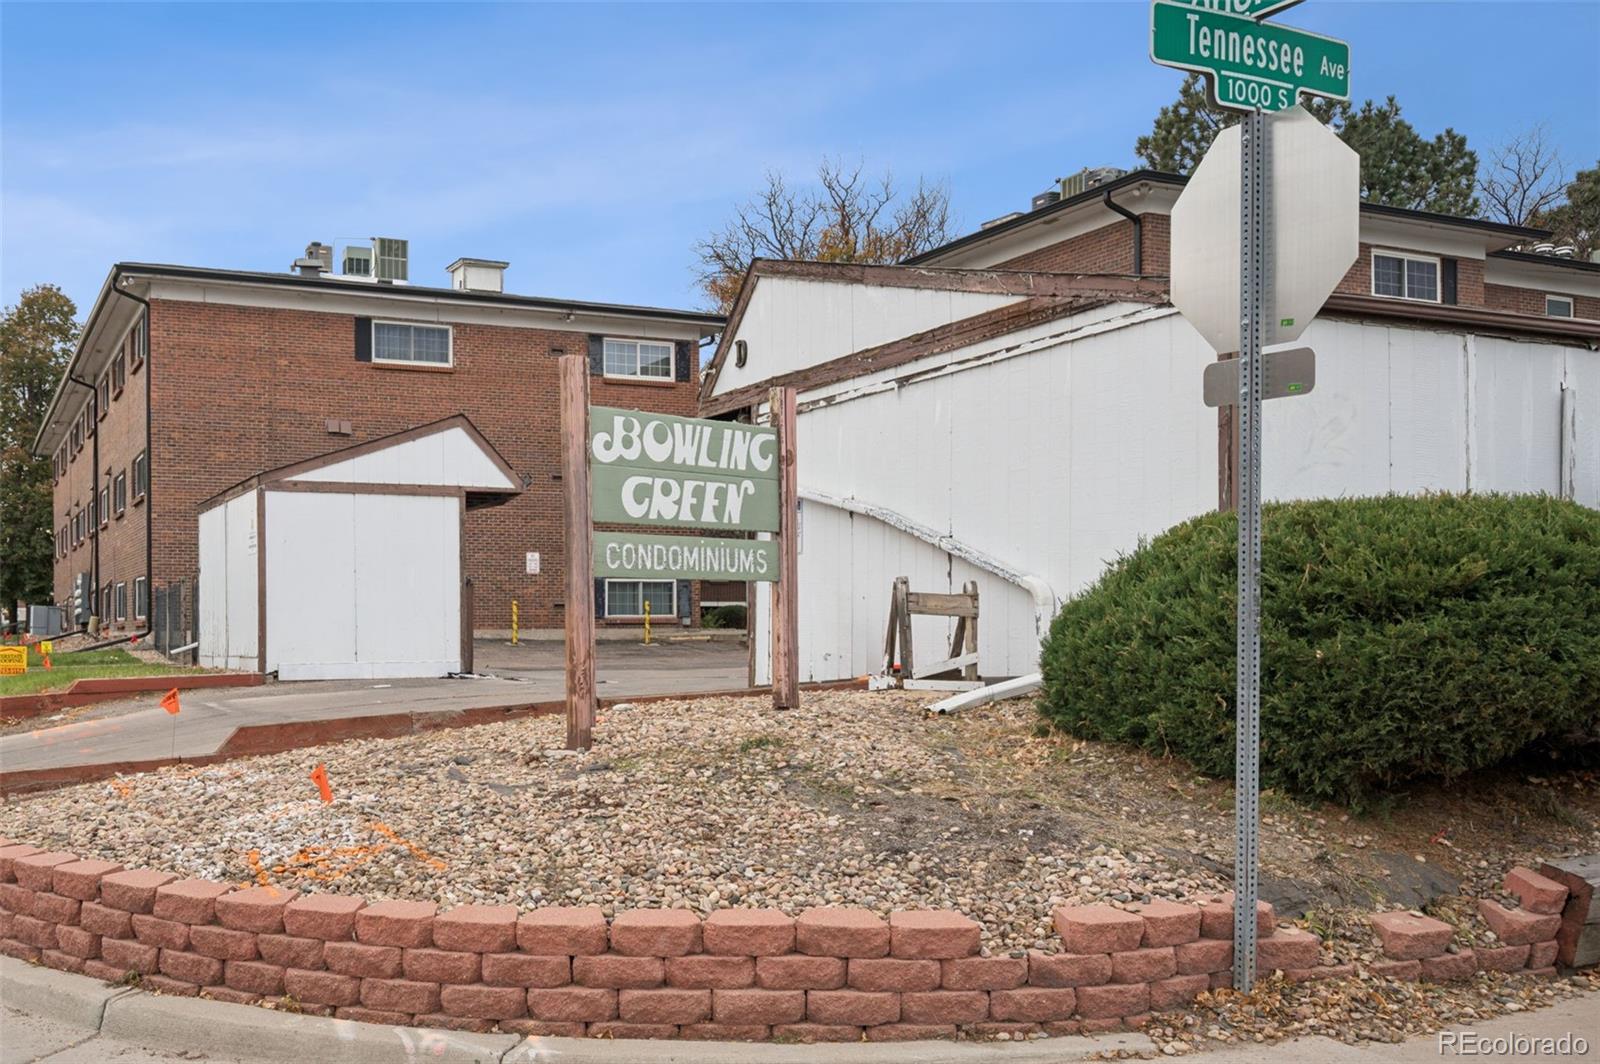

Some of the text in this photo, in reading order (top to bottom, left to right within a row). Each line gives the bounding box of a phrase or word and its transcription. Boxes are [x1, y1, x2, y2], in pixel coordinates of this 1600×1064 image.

[1186, 13, 1345, 80] Tennessee Ave
[1227, 78, 1289, 110] 1000 S
[592, 415, 776, 472] BOWLING
[621, 475, 756, 525] GREEN
[605, 539, 769, 574] CONDOMINIUMS
